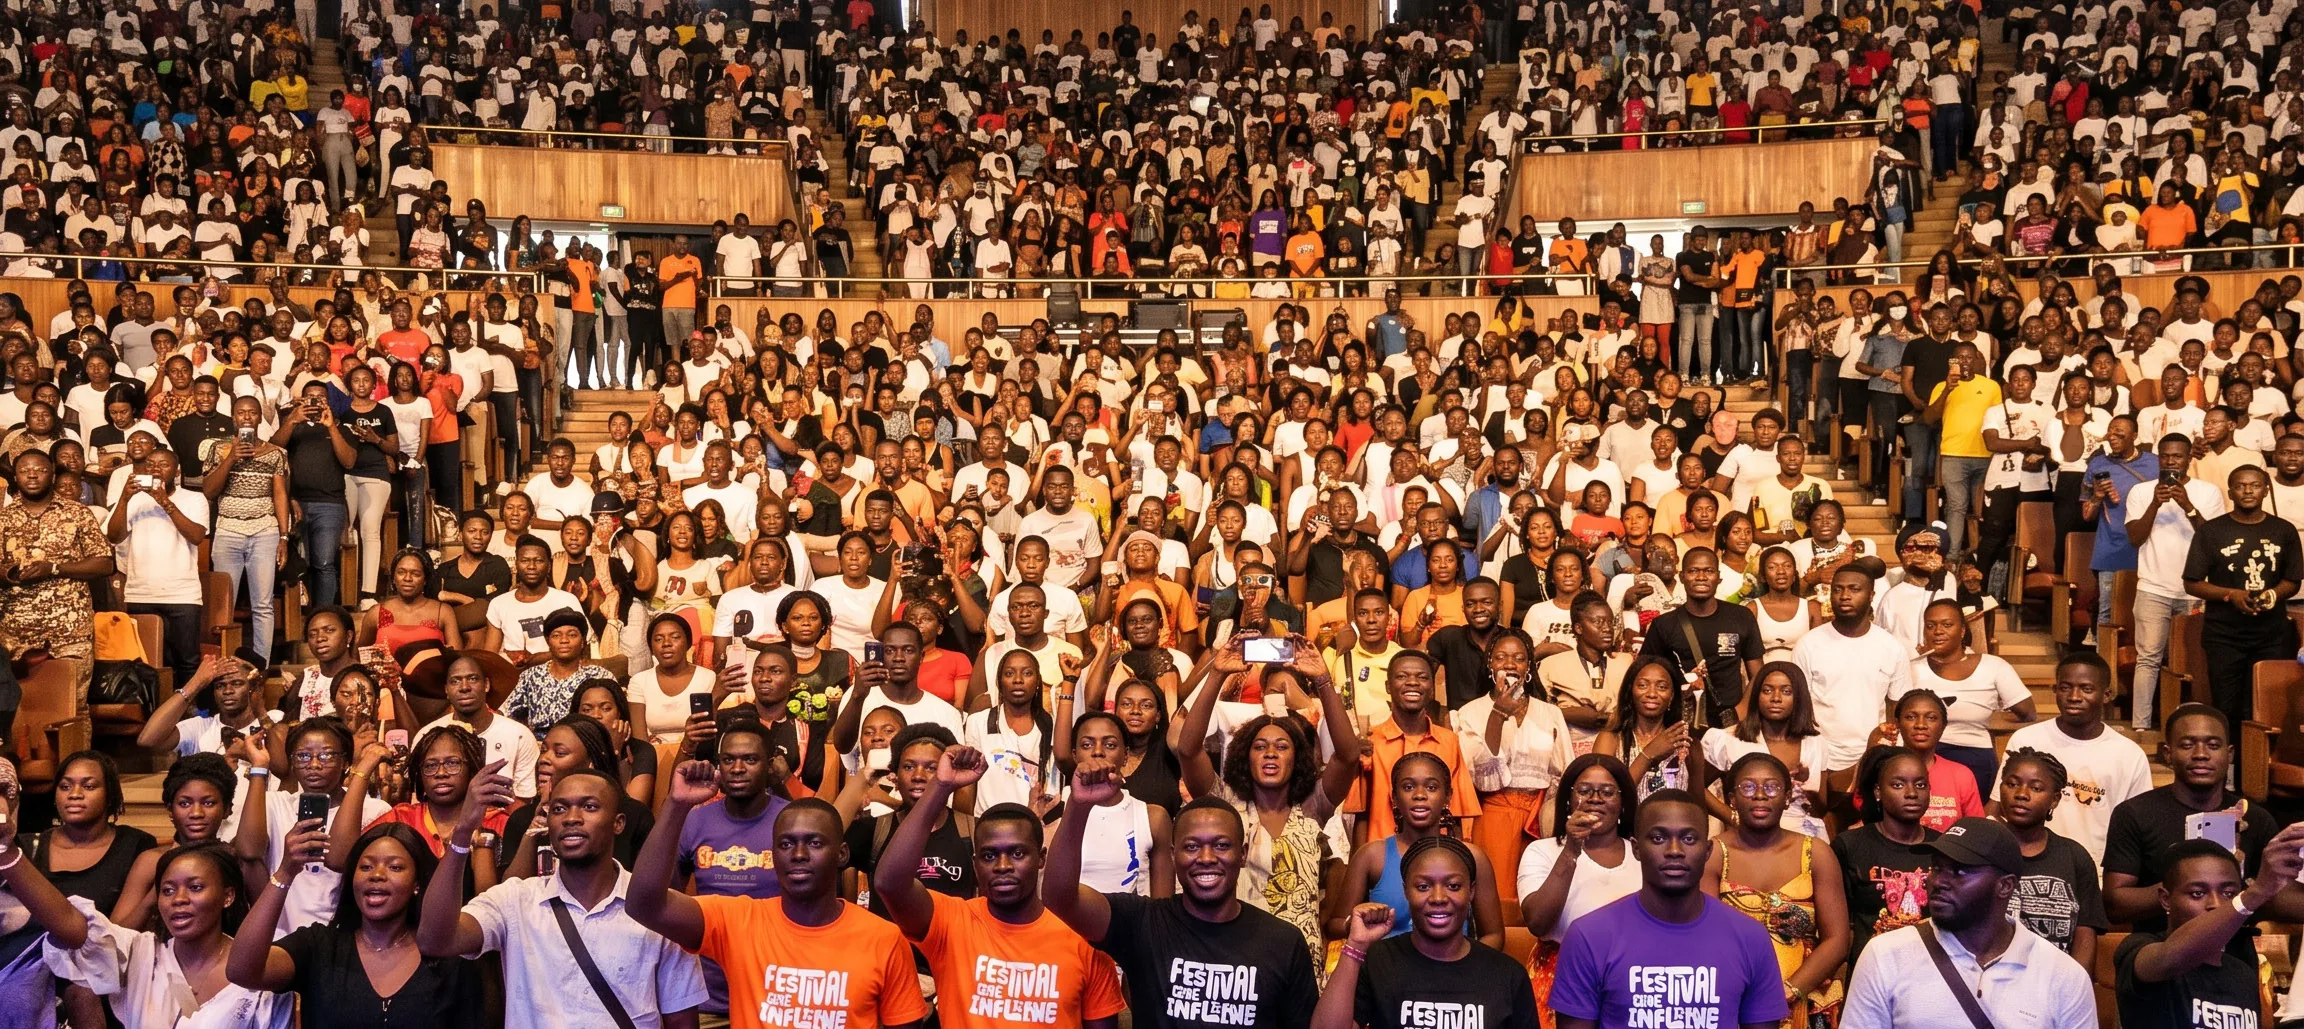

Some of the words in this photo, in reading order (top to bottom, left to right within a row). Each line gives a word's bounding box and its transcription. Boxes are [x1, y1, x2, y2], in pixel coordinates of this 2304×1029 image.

[764, 964, 850, 1007] FESTIVAL
[975, 954, 1060, 999] FESTIVAL
[1169, 957, 1259, 1002] FESTIVAL
[1628, 965, 1721, 1006] FESTIVAL
